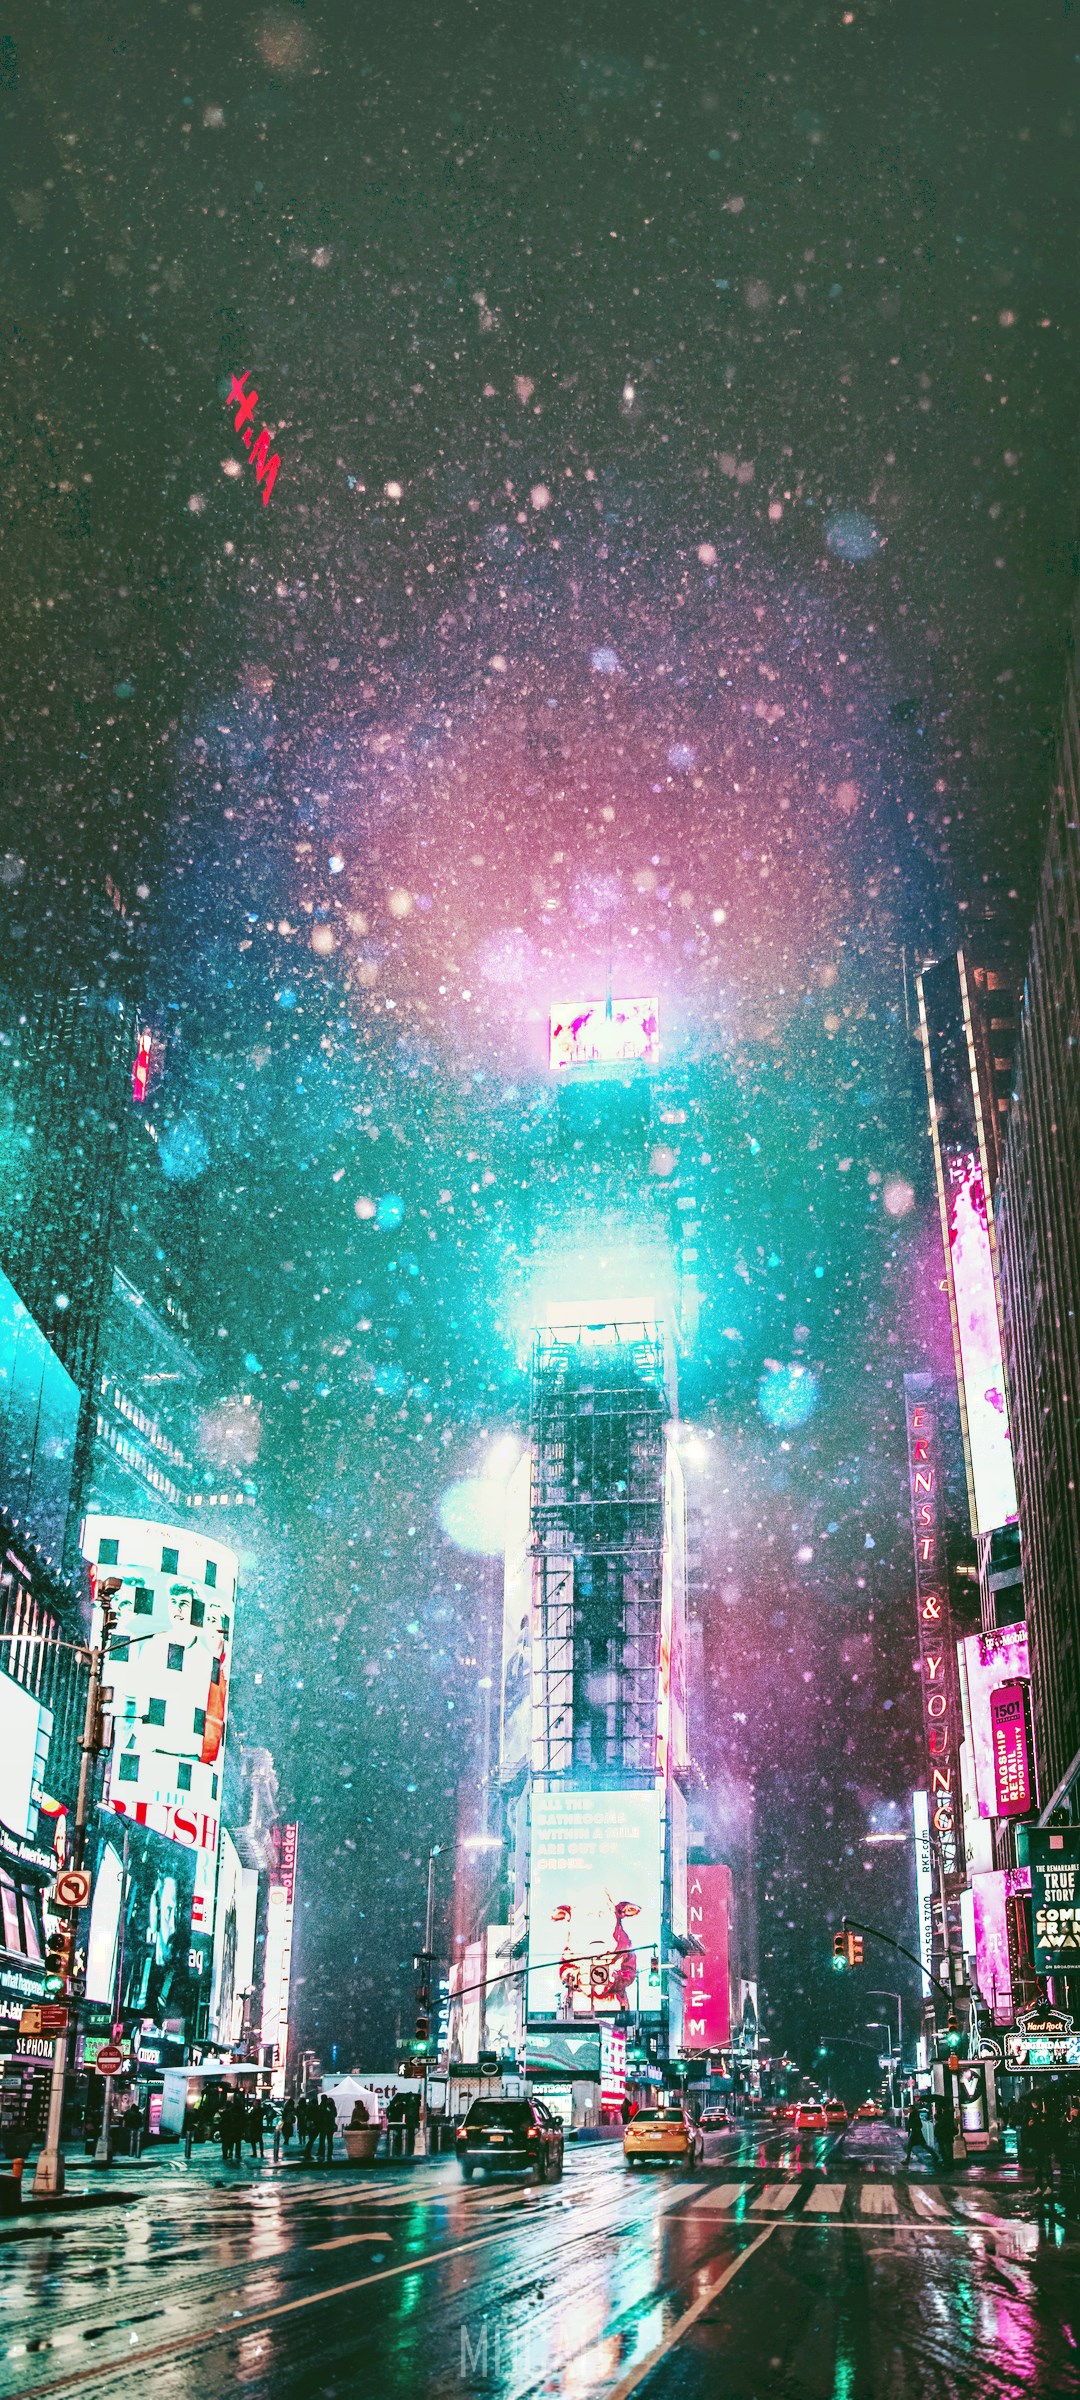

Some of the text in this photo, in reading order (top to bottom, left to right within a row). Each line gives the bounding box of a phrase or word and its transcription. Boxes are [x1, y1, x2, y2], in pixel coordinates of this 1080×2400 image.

[912, 1407, 954, 1832] ERNST & YOUNG
[994, 1701, 1020, 1718] 1501
[997, 1730, 1009, 1802] FLAGSHIP
[1007, 1750, 1019, 1801] RETAIL
[1015, 1726, 1026, 1799] OPPORTUNITY
[280, 1824, 296, 1869] Locker
[922, 1829, 930, 1873] RKF.com
[1043, 1872, 1075, 1888] TRUE
[1047, 1863, 1080, 1872] REMARKABLE
[1044, 1888, 1075, 1902] STORY
[1027, 2022, 1063, 2032] Hard Rock
[16, 2037, 53, 2058] SEPHORA
